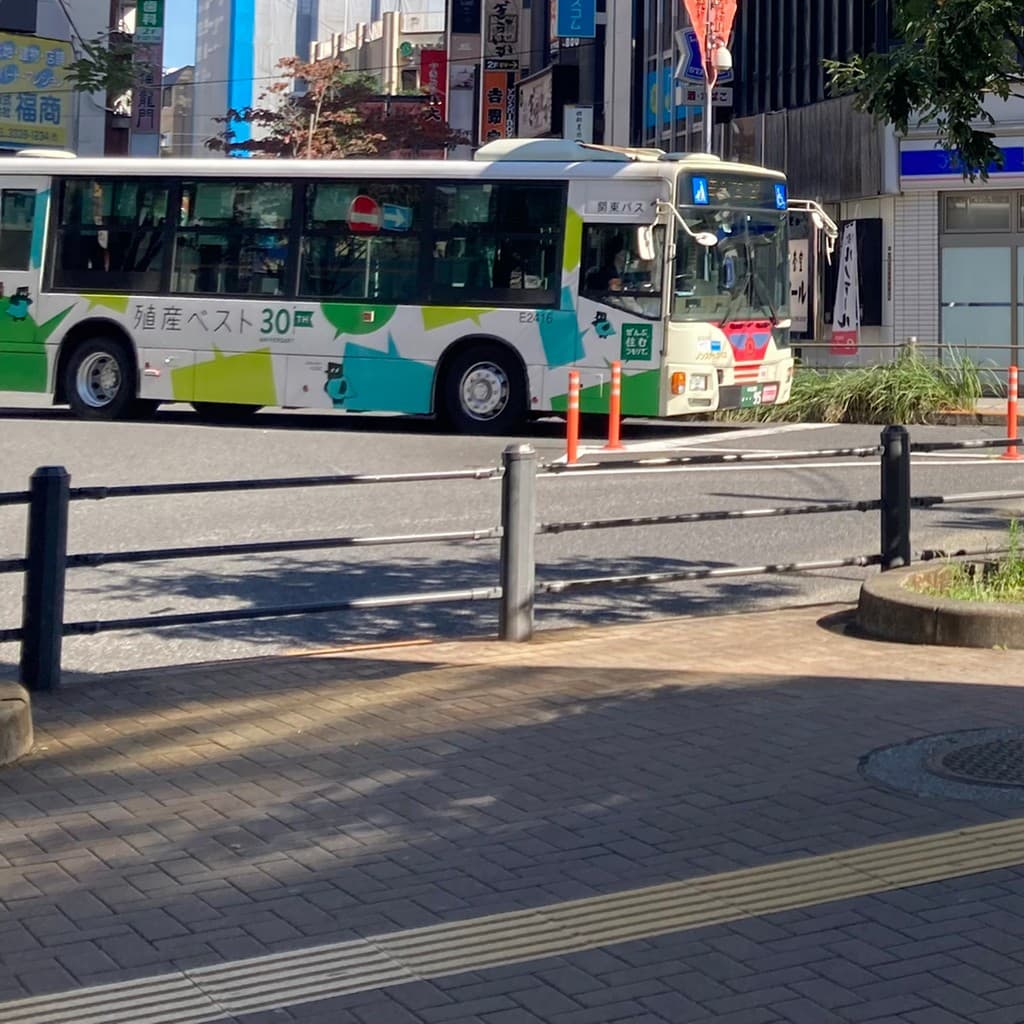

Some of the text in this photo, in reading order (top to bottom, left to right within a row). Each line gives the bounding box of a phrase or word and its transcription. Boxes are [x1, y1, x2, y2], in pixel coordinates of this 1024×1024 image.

[597, 200, 645, 214] 関東バス
[133, 304, 253, 333] 殖産ベスト
[260, 308, 290, 334] 30
